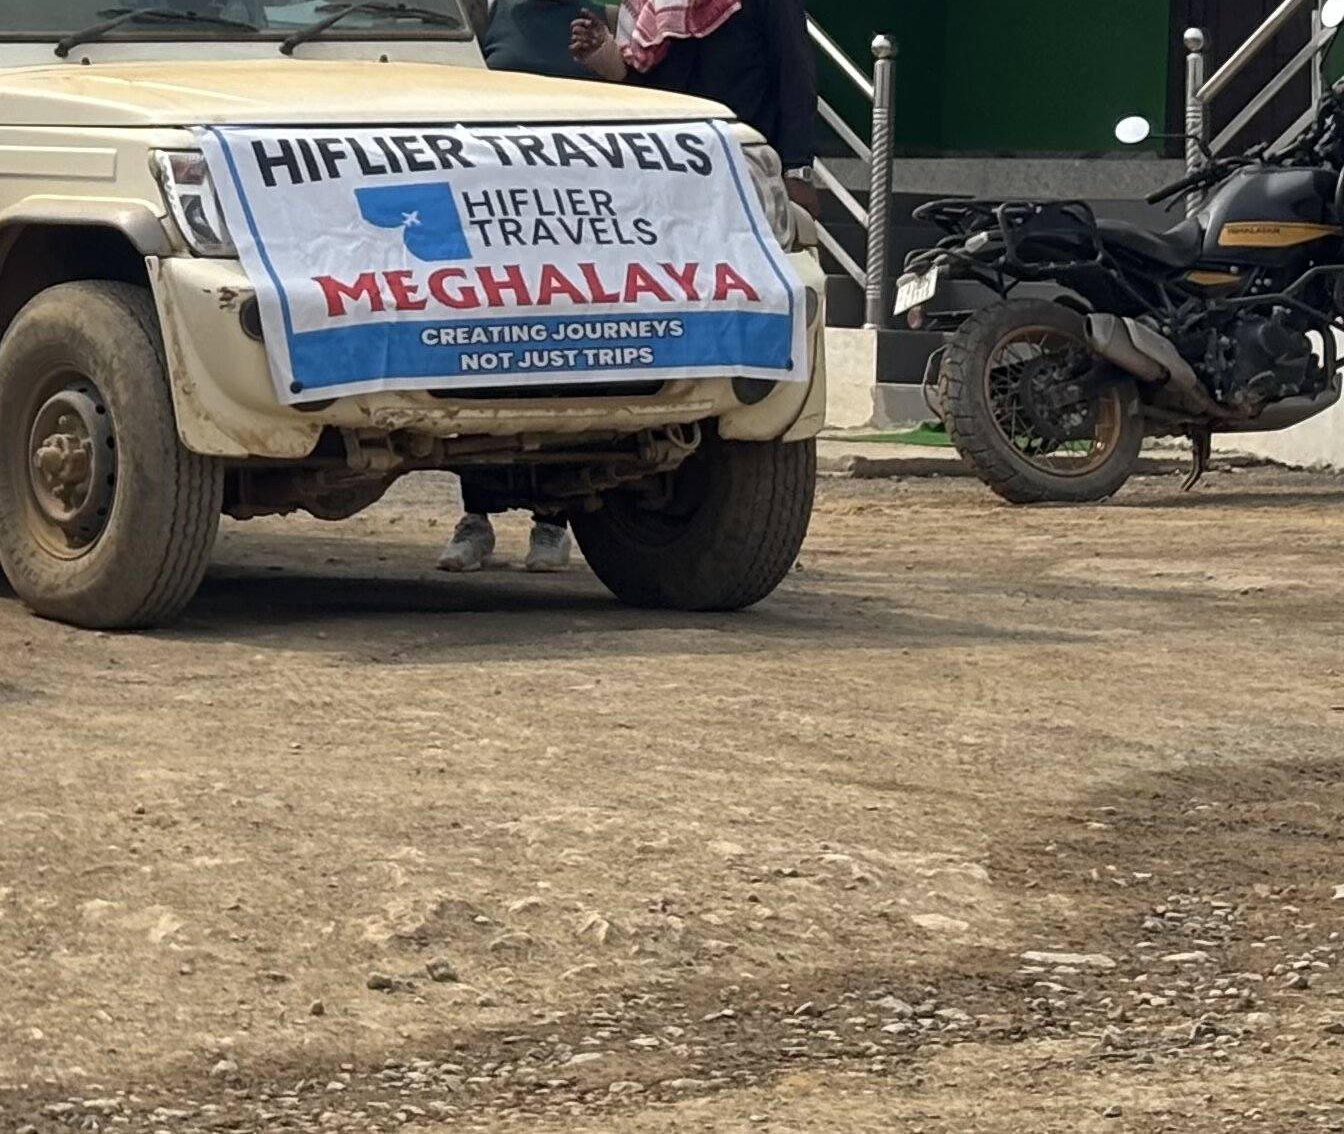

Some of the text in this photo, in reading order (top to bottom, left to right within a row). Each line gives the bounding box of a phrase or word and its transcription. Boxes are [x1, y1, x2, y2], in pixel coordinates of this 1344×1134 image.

[251, 132, 713, 188] HIFLIER TRAVELS
[462, 189, 617, 219] HIFLIER
[468, 217, 658, 248] TRAVELS
[311, 262, 761, 318] MEGHALAYA
[421, 319, 684, 346] CREATING JOURNEYS
[460, 346, 654, 371] NOT JUST TRIPS
